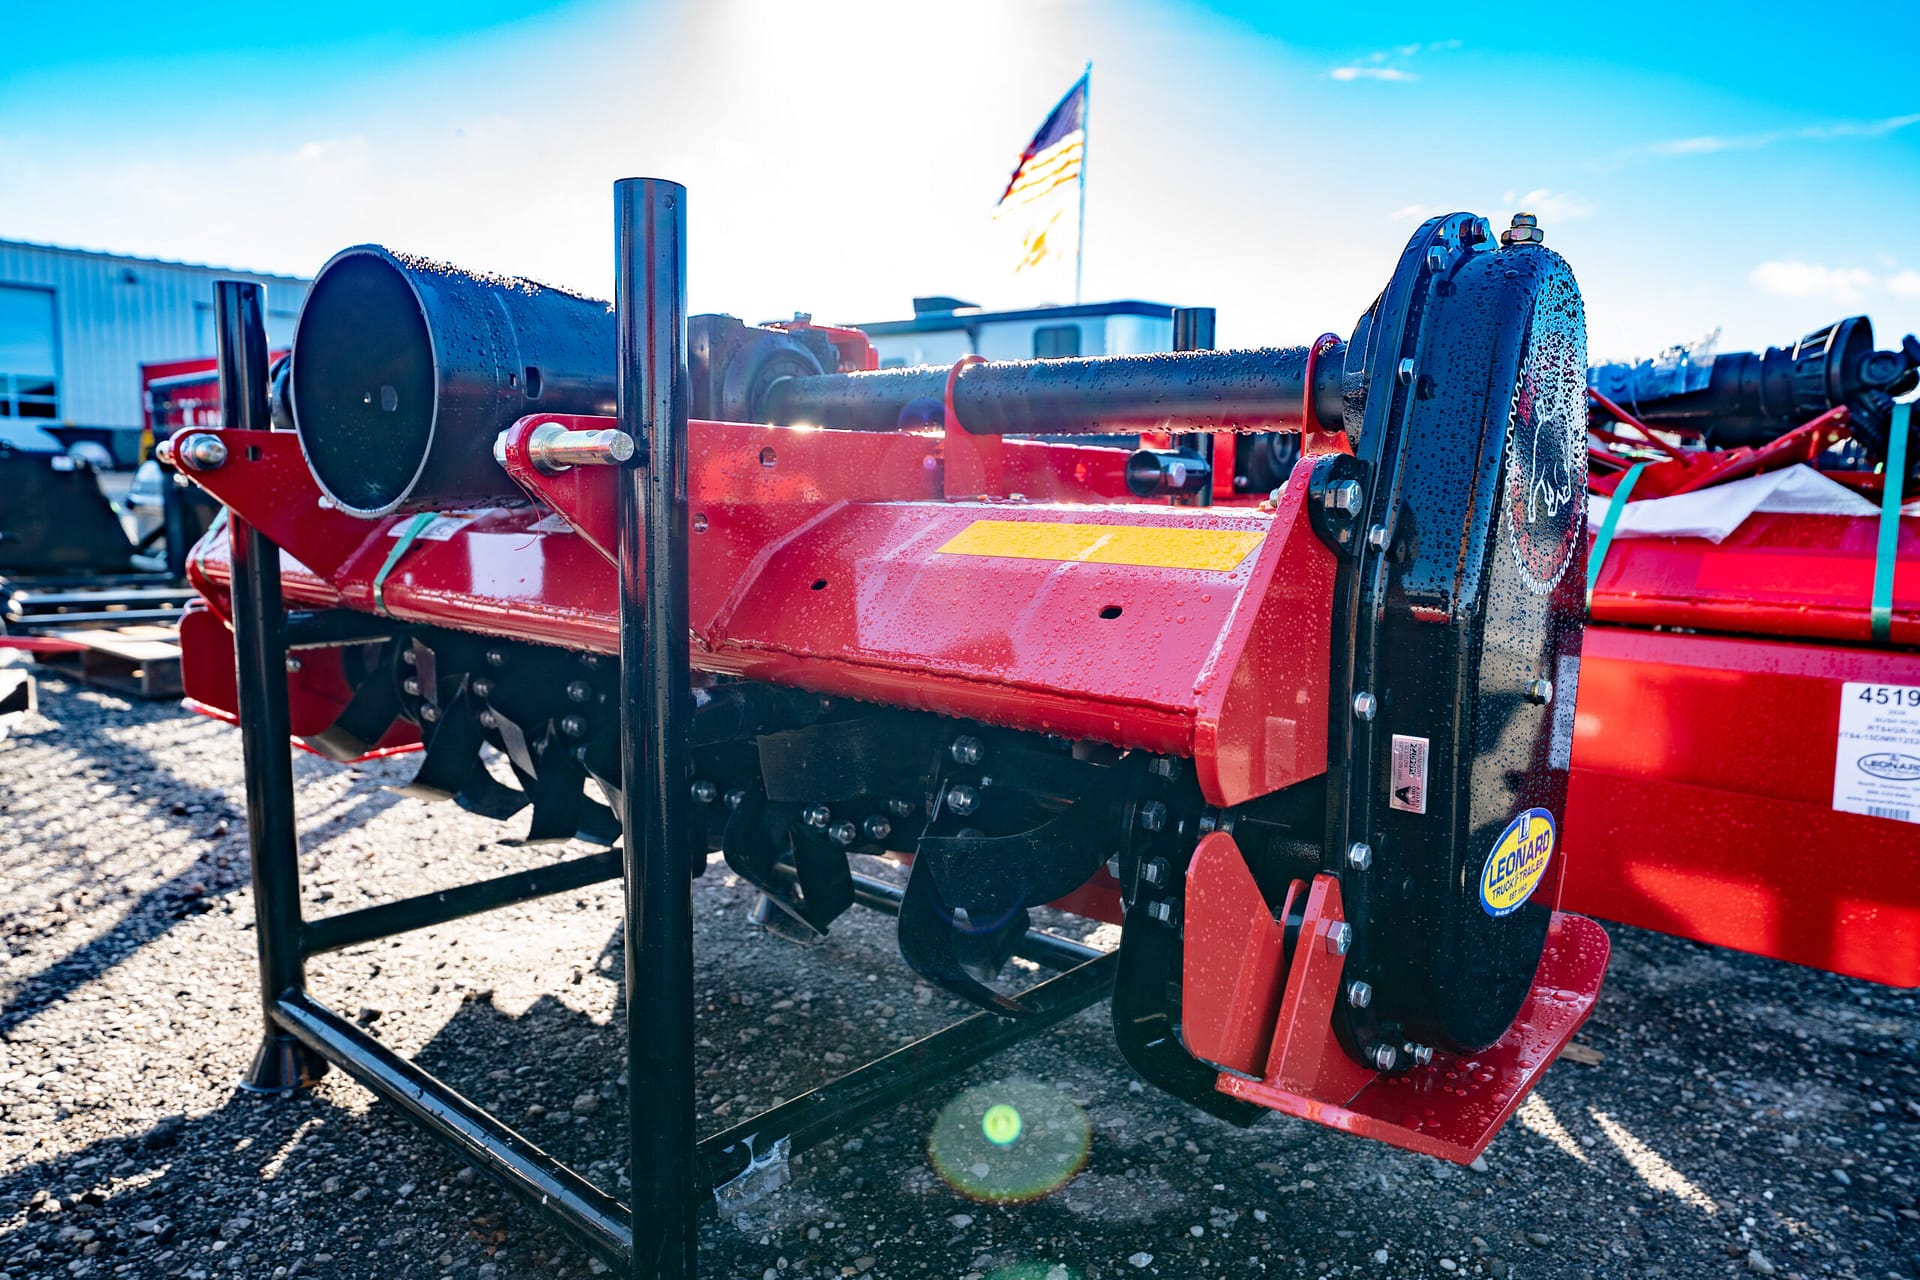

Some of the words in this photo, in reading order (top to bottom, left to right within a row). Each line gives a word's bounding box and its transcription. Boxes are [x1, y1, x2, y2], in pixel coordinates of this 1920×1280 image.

[1859, 687, 1920, 707] 4519
[1489, 829, 1550, 889] LEONARD
[1492, 878, 1515, 900] TRUCK
[1519, 857, 1544, 882] TRAILER
